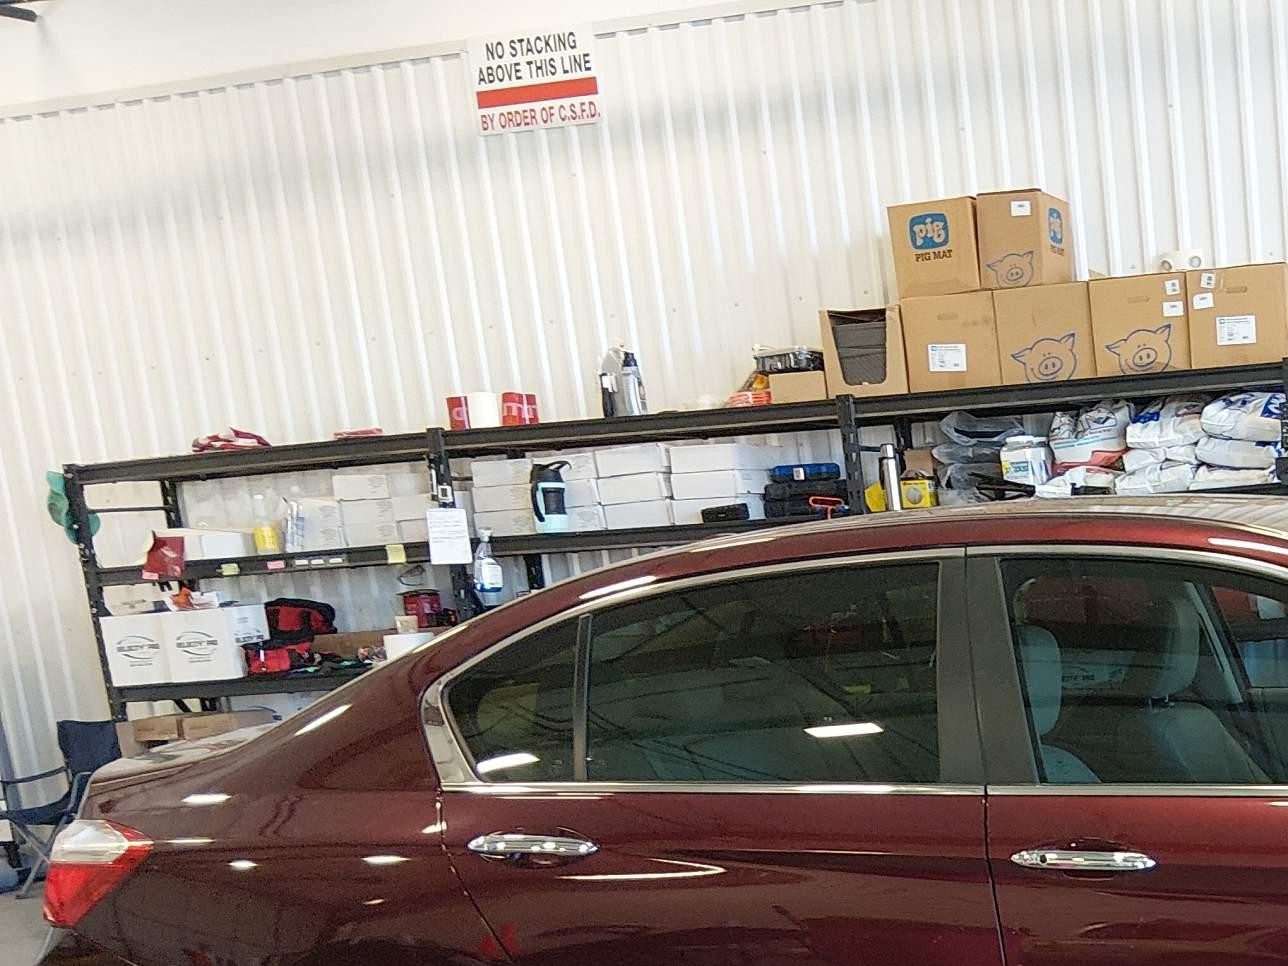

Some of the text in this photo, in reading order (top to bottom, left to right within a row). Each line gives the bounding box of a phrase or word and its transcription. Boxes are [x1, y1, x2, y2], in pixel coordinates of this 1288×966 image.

[485, 31, 577, 61] NO STACKING
[477, 53, 593, 86] ABOVE THIS LINE
[480, 100, 601, 132] BY ORDER OF C.S.F.D.
[914, 249, 953, 263] PIG MAT
